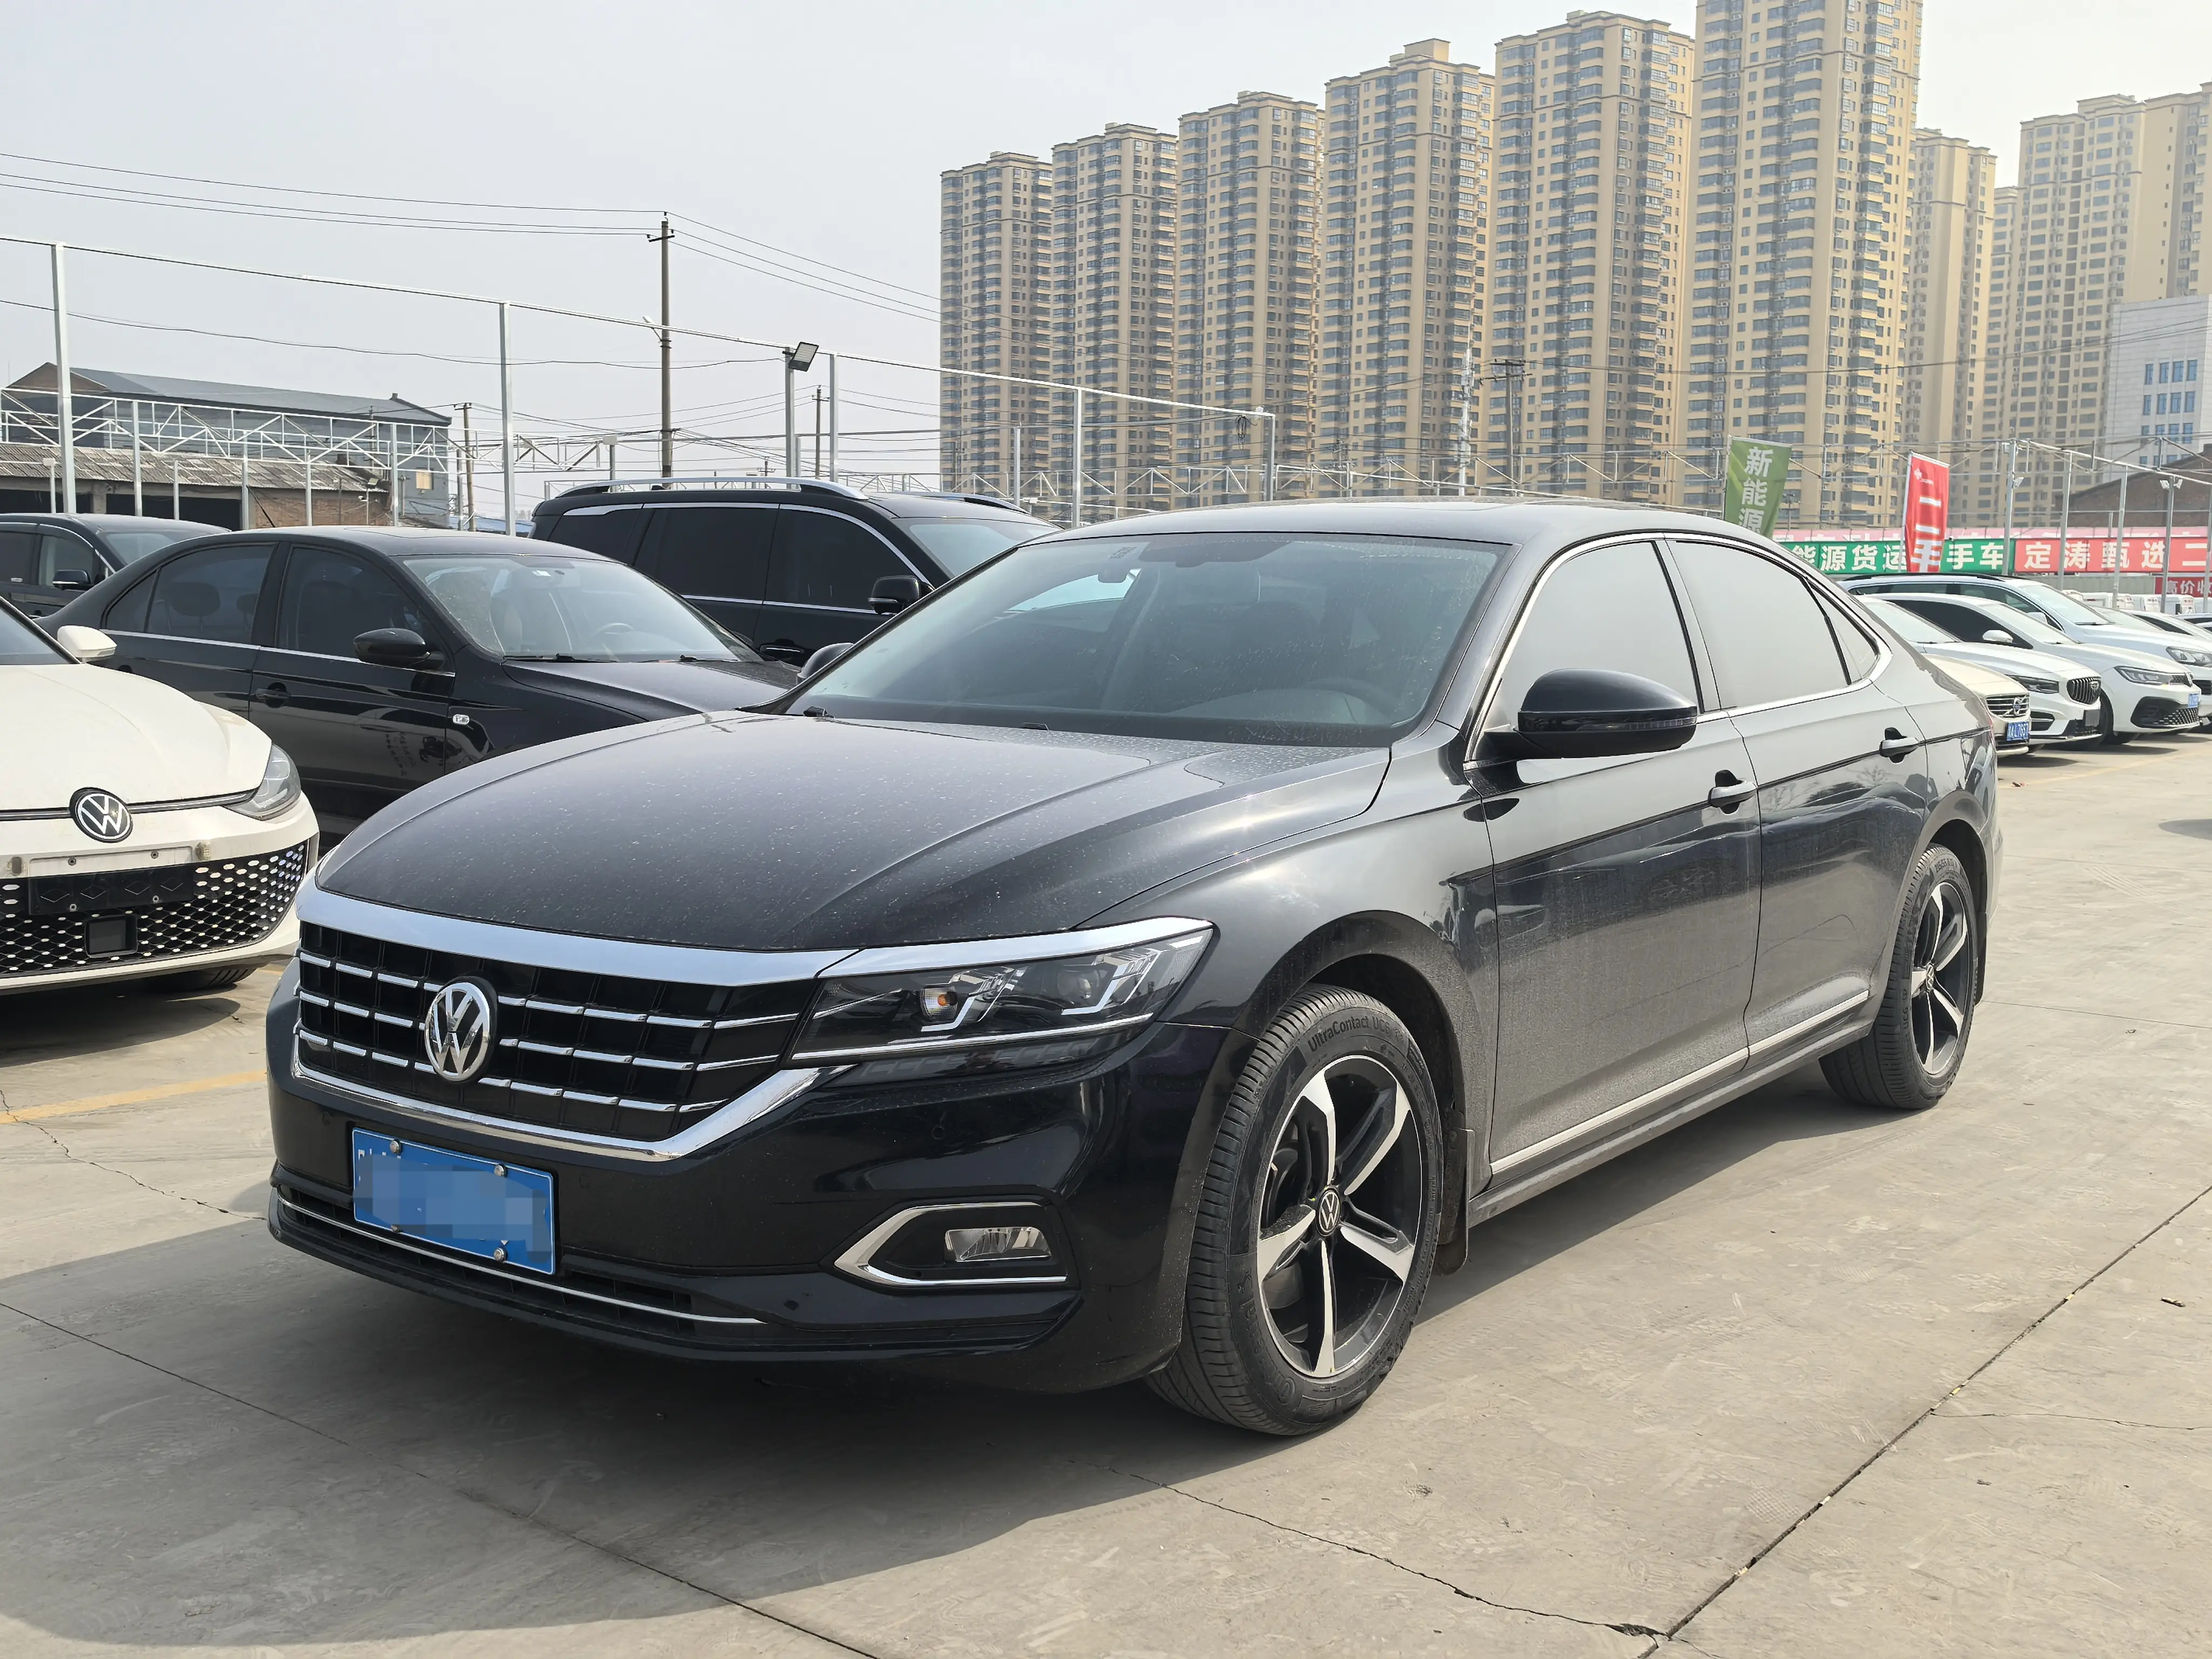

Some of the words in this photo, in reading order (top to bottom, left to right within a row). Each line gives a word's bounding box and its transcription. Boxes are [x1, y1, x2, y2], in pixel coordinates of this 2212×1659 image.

[1738, 446, 1773, 533] 新能源
[2024, 541, 2208, 569] 定涛甄选二
[77, 793, 131, 839] VW
[424, 982, 490, 1082] VW
[1307, 1015, 1369, 1053] UltraContact
[1319, 1190, 1340, 1233] VW
